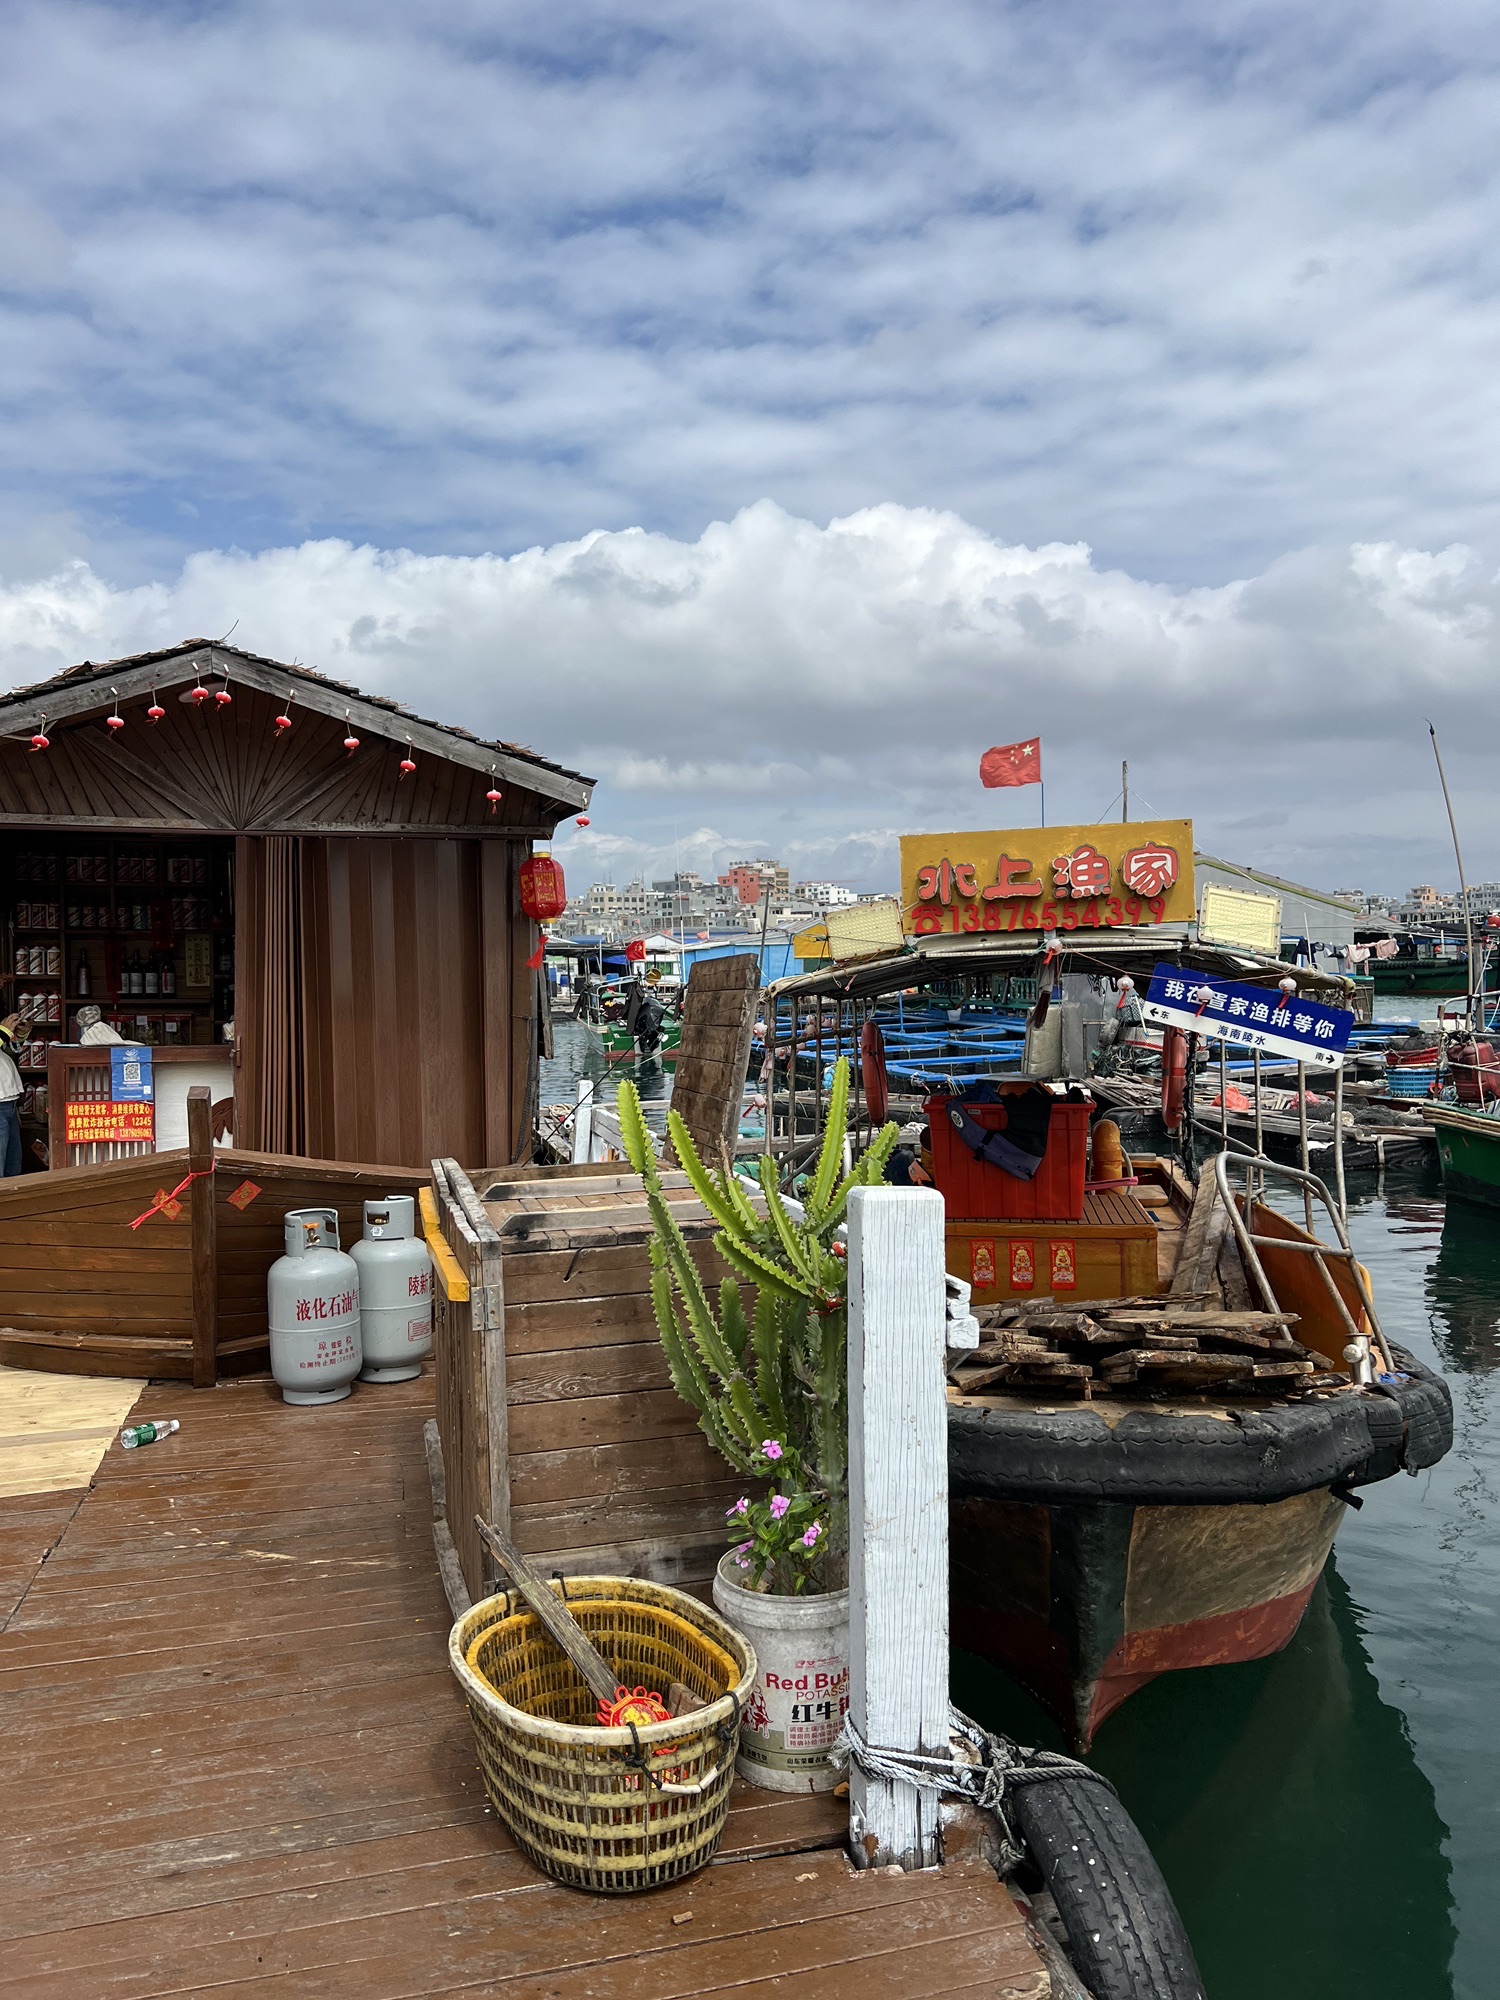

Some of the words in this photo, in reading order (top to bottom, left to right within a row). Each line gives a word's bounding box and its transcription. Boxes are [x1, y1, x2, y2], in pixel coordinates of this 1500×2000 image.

[917, 841, 1181, 905] 水上渔家
[948, 897, 1166, 933] 13876554399
[1160, 1010, 1170, 1020] 东
[1217, 1024, 1266, 1046] 海南陵水
[1315, 1051, 1325, 1062] 南
[296, 1288, 359, 1321] 液化石油气
[766, 1673, 808, 1690] Red
